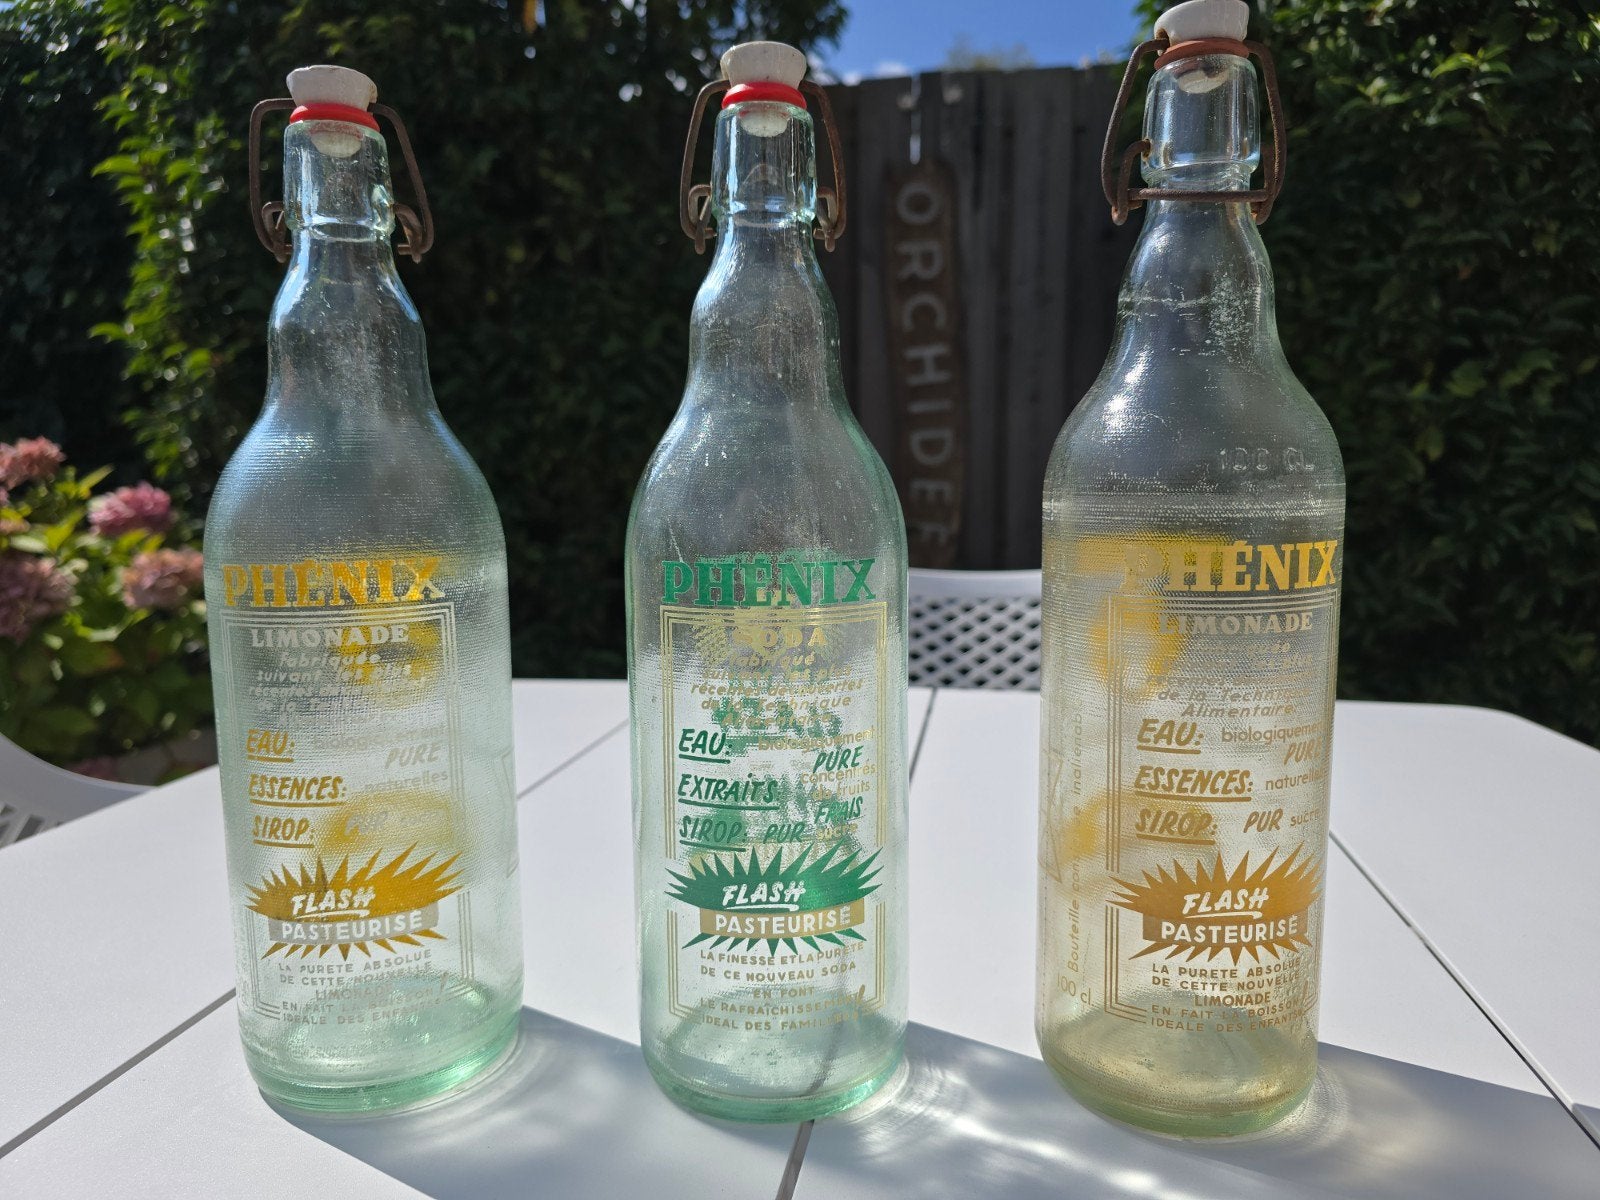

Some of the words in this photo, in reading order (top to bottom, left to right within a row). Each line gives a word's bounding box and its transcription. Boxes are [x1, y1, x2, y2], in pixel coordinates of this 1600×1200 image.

[251, 624, 409, 648] LIMONADE
[1159, 611, 1313, 636] LIMONADE
[732, 626, 828, 649] SODA
[246, 729, 295, 757] EAU:
[679, 728, 731, 757] EAU:
[1137, 718, 1204, 748] EAU:
[384, 741, 442, 770] PURE
[813, 745, 865, 773] PURE
[249, 773, 347, 801] ESSENCES:
[837, 779, 871, 799] fruits
[1134, 765, 1253, 795] ESSENCES:
[815, 795, 863, 824] FRAIS
[252, 814, 315, 843] SIROP:
[679, 815, 748, 845] SIROP:
[764, 821, 806, 845] PUR
[1135, 808, 1219, 837] SIROP:
[1243, 808, 1284, 834] PUR
[290, 885, 376, 917] FLASH
[722, 879, 807, 906] FLASH
[1182, 887, 1270, 914] FLASH
[1067, 899, 1081, 973] Bouteille
[363, 948, 432, 972] ABSOLUE
[700, 950, 715, 962] LA
[719, 953, 774, 966] FINESSE
[1152, 963, 1170, 975] LA
[1178, 967, 1238, 979] PURETE
[1247, 957, 1300, 978] ABSOLUE
[280, 973, 295, 985] DE
[301, 976, 345, 988] CETTE
[700, 965, 717, 978] DE
[724, 970, 741, 981] CE
[747, 968, 814, 983] NOUVEAU
[821, 961, 856, 977] SODA
[1152, 976, 1170, 988] DE
[1180, 980, 1228, 991] CETTE
[1237, 971, 1300, 991] NOUVELLE
[700, 998, 716, 1010] LE
[753, 987, 773, 999] EN
[780, 986, 814, 998] FONT
[1194, 991, 1271, 1008] LIMONADE
[702, 1014, 738, 1030] IDEAL
[745, 1018, 772, 1031] DES
[1152, 1004, 1172, 1016] EN
[1181, 1009, 1214, 1019] FAIT
[1151, 1017, 1205, 1032] IDEALE
[1216, 1022, 1243, 1033] DES
